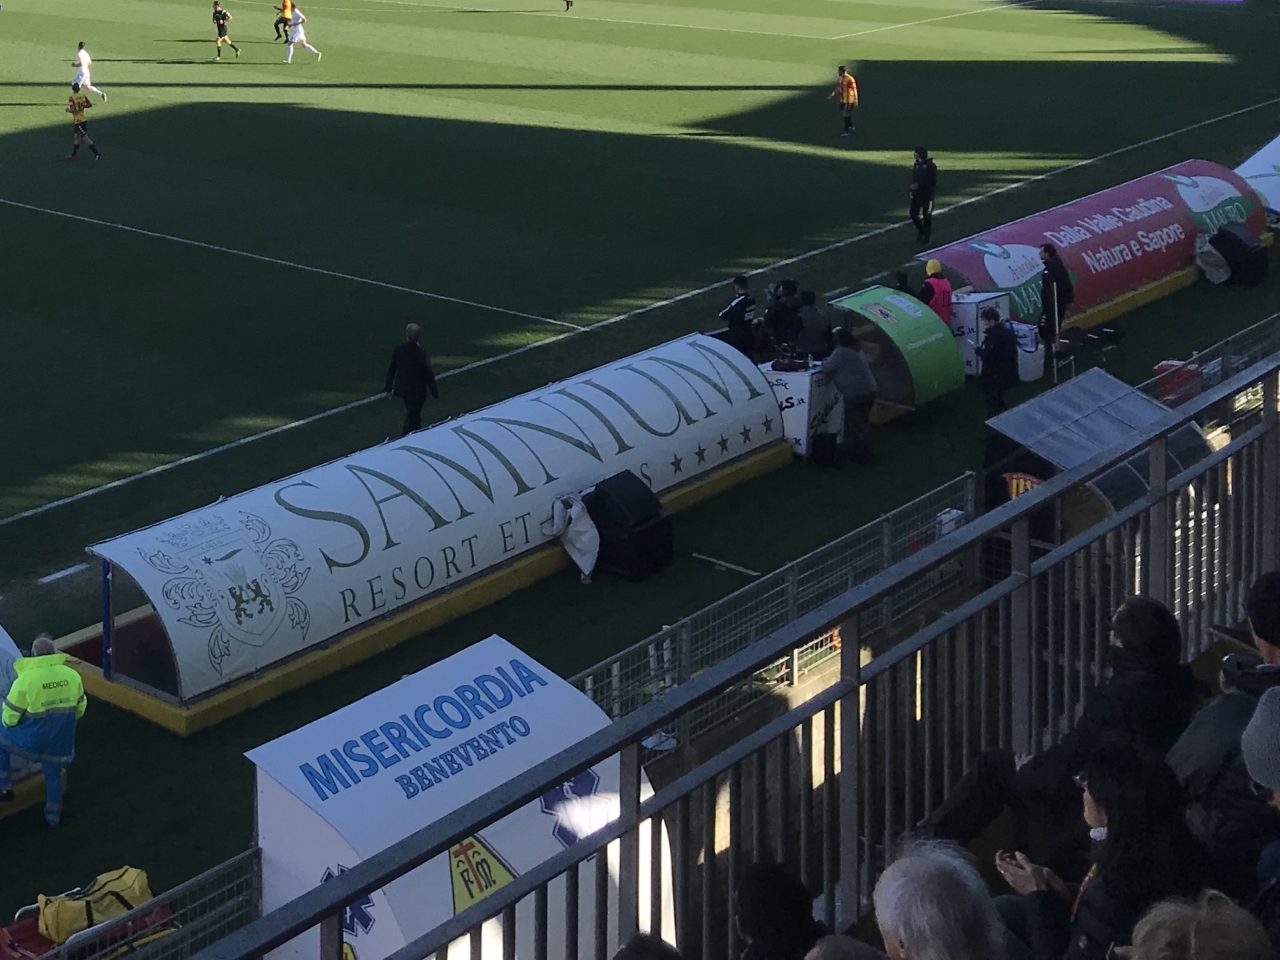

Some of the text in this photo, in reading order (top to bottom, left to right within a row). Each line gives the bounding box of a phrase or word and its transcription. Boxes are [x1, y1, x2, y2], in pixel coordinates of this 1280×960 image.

[1043, 196, 1174, 248] Dalla Valle Caudina
[1081, 223, 1186, 274] Natura e Sapore
[273, 340, 766, 575] SAMNIUM
[339, 512, 533, 624] RESORT ET
[42, 679, 69, 690] MEDICO
[299, 658, 548, 801] MISERICORDIA
[394, 715, 530, 799] BENEVENTO
